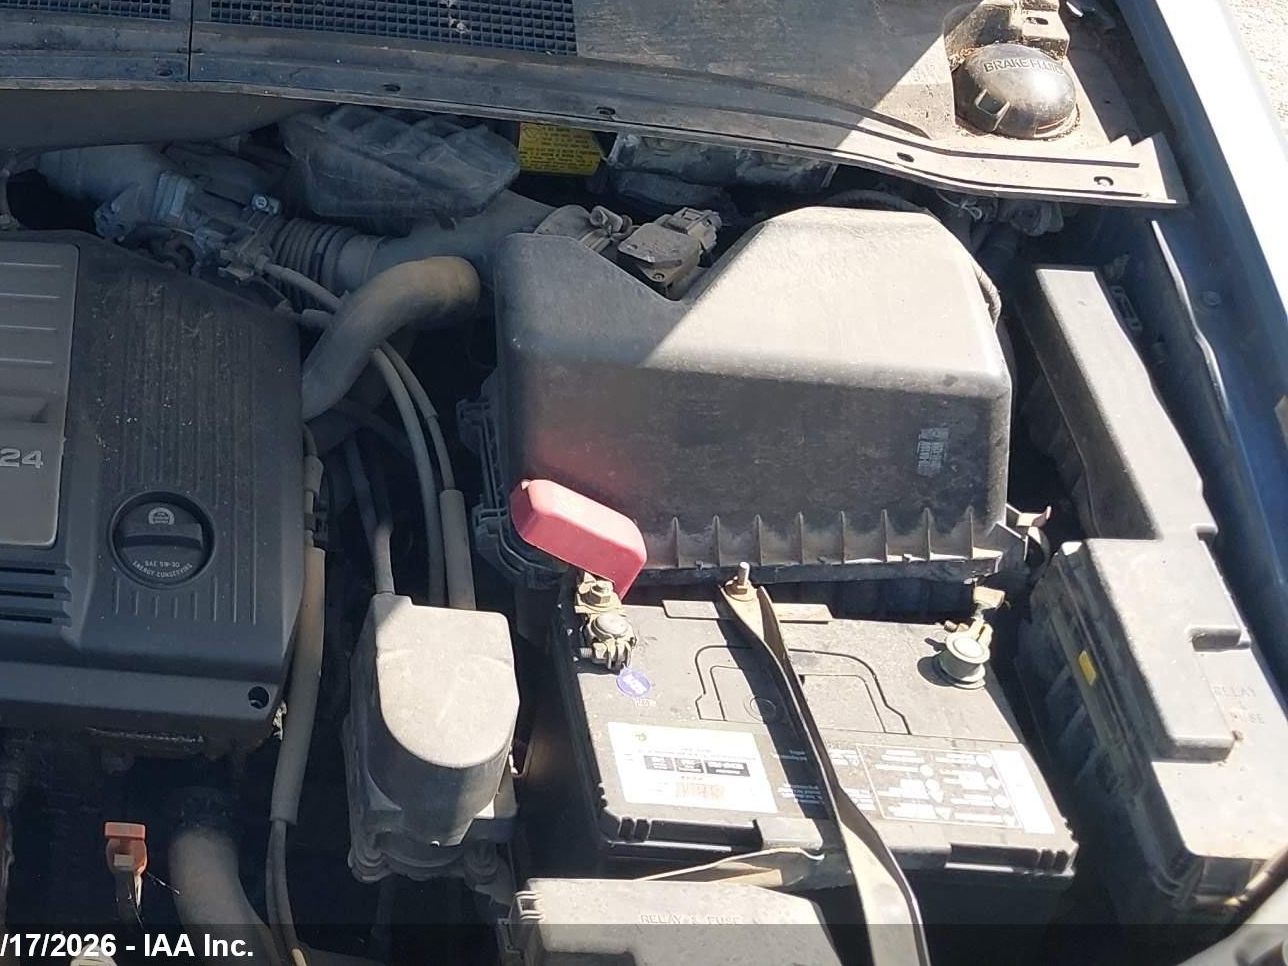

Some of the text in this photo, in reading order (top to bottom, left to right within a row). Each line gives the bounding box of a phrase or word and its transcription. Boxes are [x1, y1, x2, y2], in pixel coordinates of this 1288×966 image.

[983, 57, 1064, 75] BRAKE FLUID
[0, 448, 44, 469] 24
